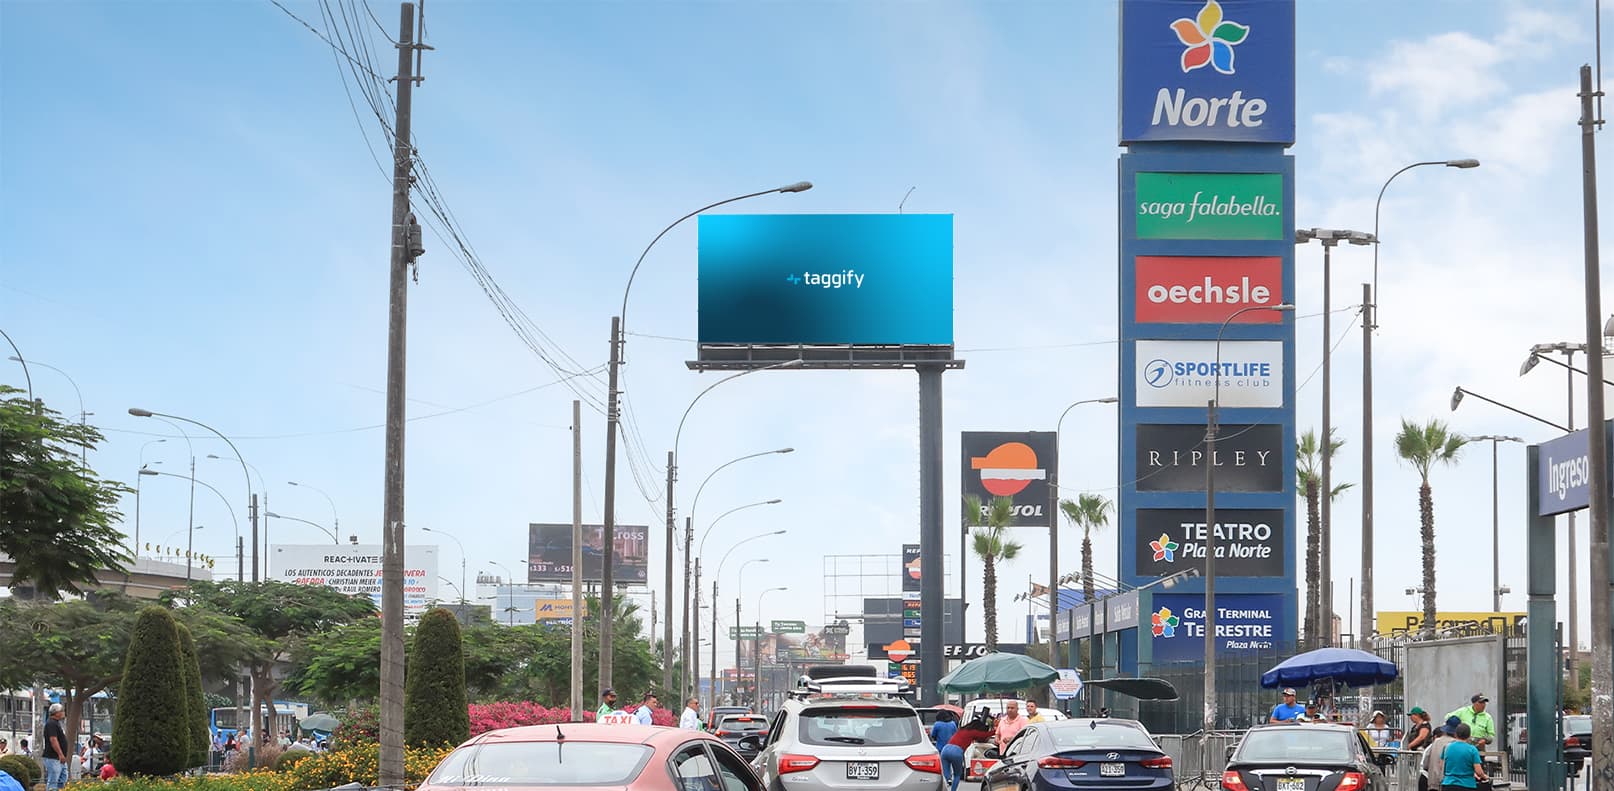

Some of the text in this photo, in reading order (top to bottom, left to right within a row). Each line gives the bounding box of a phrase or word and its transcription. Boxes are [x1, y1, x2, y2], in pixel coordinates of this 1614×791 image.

[1152, 88, 1268, 128] Norte
[1139, 200, 1185, 219] saga
[803, 269, 865, 289] taggify
[1147, 276, 1271, 304] oechsle
[1174, 362, 1271, 377] SPORTLIFE
[1237, 378, 1270, 388] club
[1149, 450, 1271, 467] RIPLEY
[1548, 455, 1589, 501] Ingreso
[980, 504, 1043, 517] RSOL
[1181, 523, 1272, 541] TEATRO
[1182, 543, 1272, 559] Plaa Norte
[285, 569, 296, 577] LOS
[336, 569, 373, 577] DECADENTES
[403, 569, 426, 577] IVERA
[1184, 607, 1272, 619] GRA TERMINAL
[1184, 622, 1272, 637] TERESTRE
[1226, 640, 1248, 649] Plaza
[604, 715, 632, 725] TAXI
